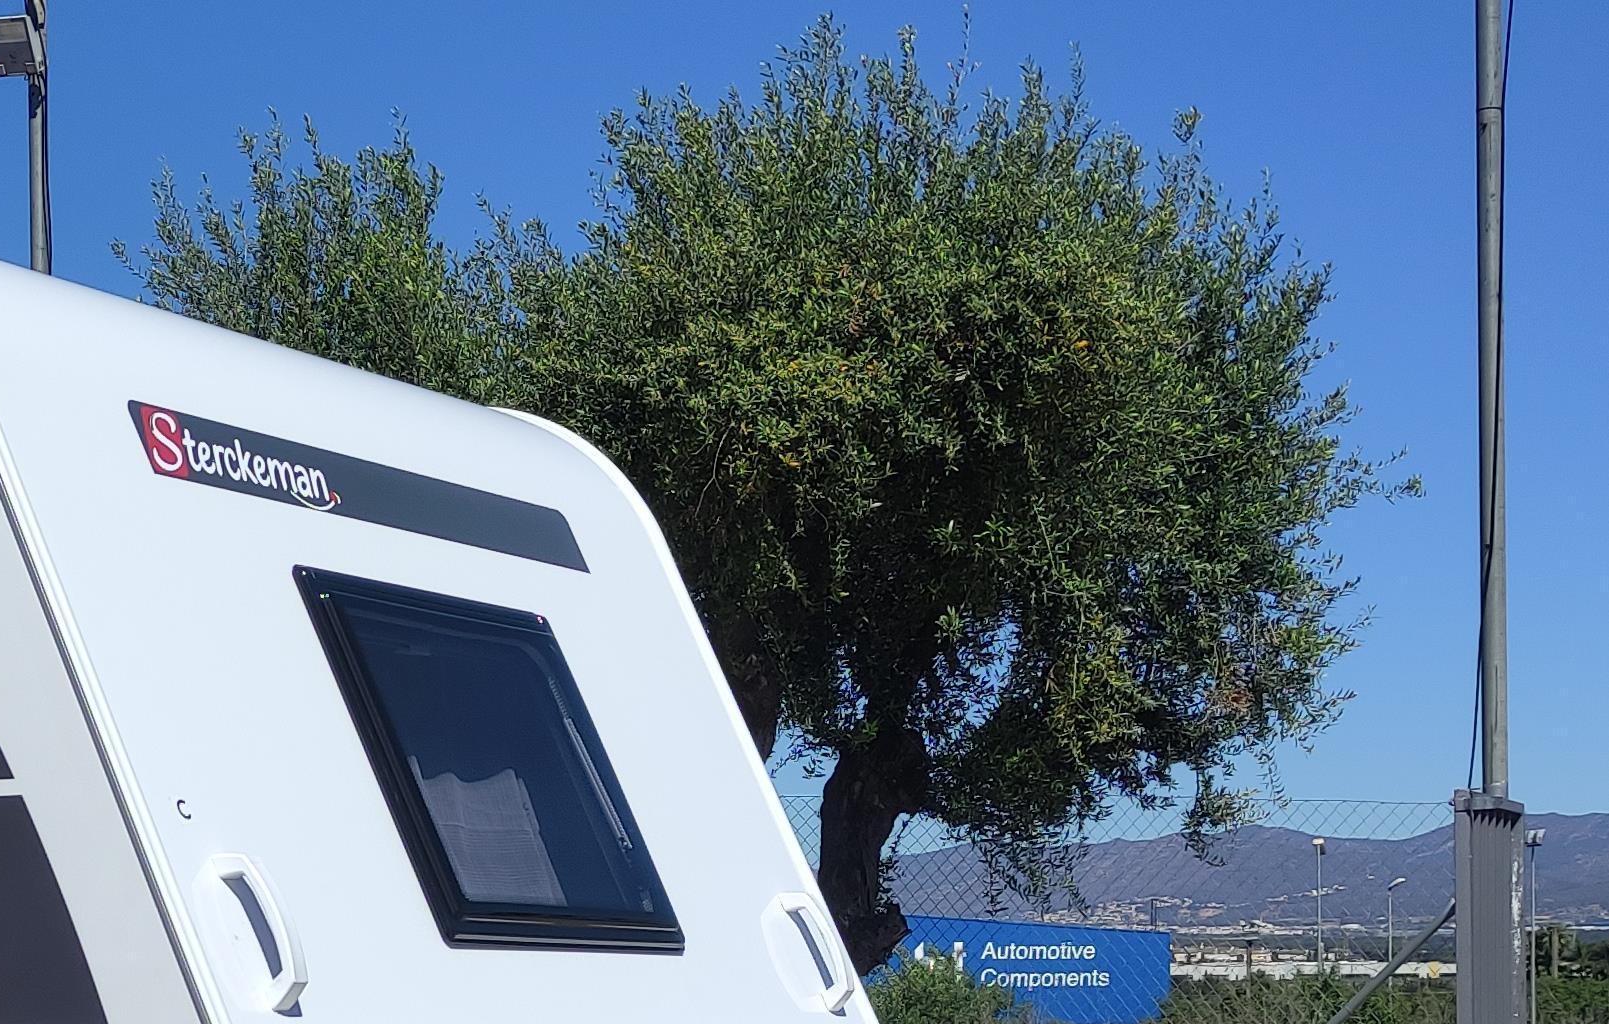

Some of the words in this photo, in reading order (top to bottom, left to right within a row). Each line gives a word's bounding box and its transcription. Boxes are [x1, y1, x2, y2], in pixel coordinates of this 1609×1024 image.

[150, 411, 330, 502] Sterckeman
[980, 941, 1096, 960] Automotive
[980, 968, 1110, 992] Components
